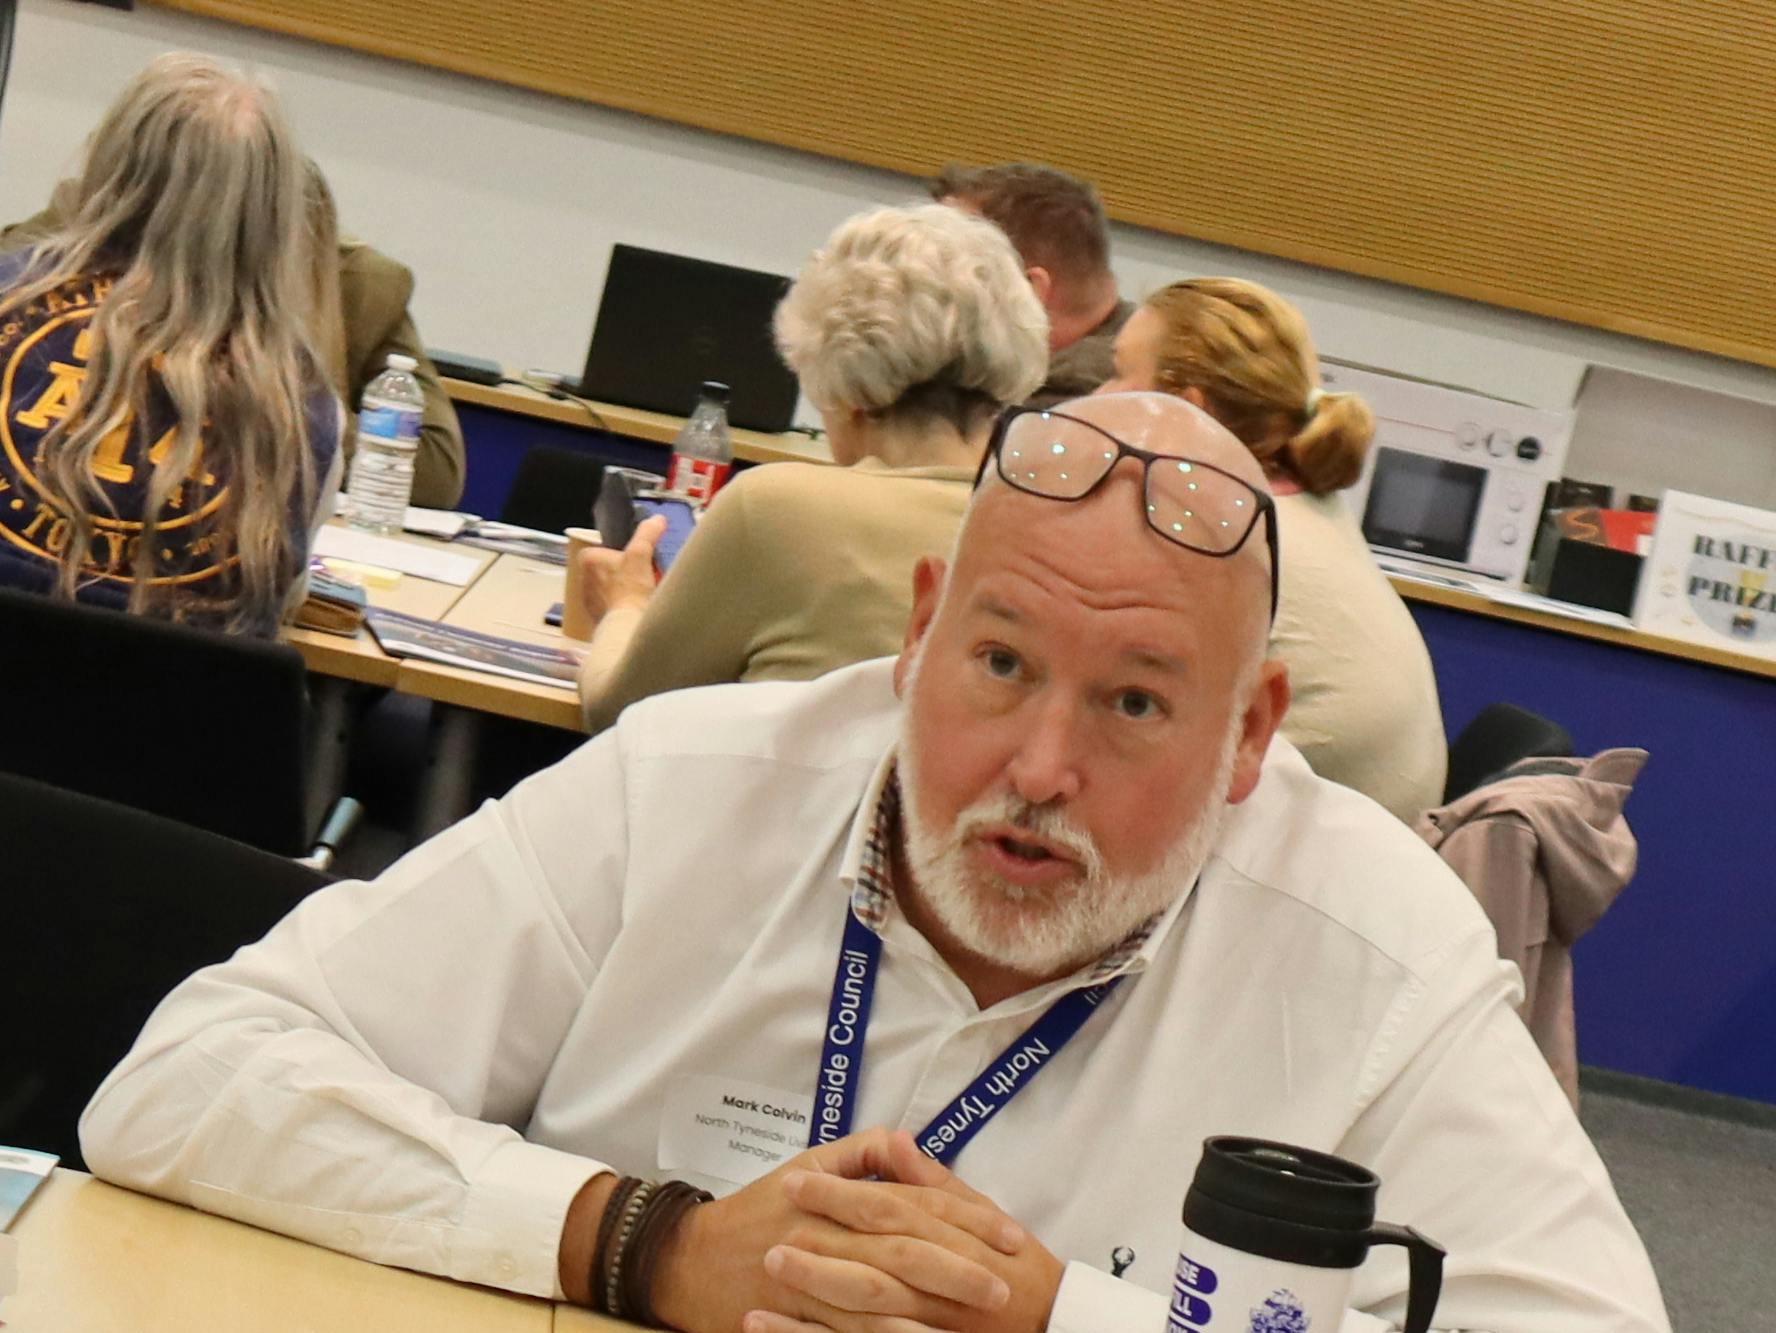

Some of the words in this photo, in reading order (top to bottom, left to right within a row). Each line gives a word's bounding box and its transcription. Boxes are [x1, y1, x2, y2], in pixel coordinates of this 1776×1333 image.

[828, 949, 870, 1047] Council
[985, 1036, 1052, 1101] North
[722, 1094, 759, 1113] Mark
[761, 1104, 806, 1125] Colvin
[695, 1113, 730, 1129] North
[732, 1120, 786, 1144] Tyneside
[727, 1139, 782, 1162] Manager
